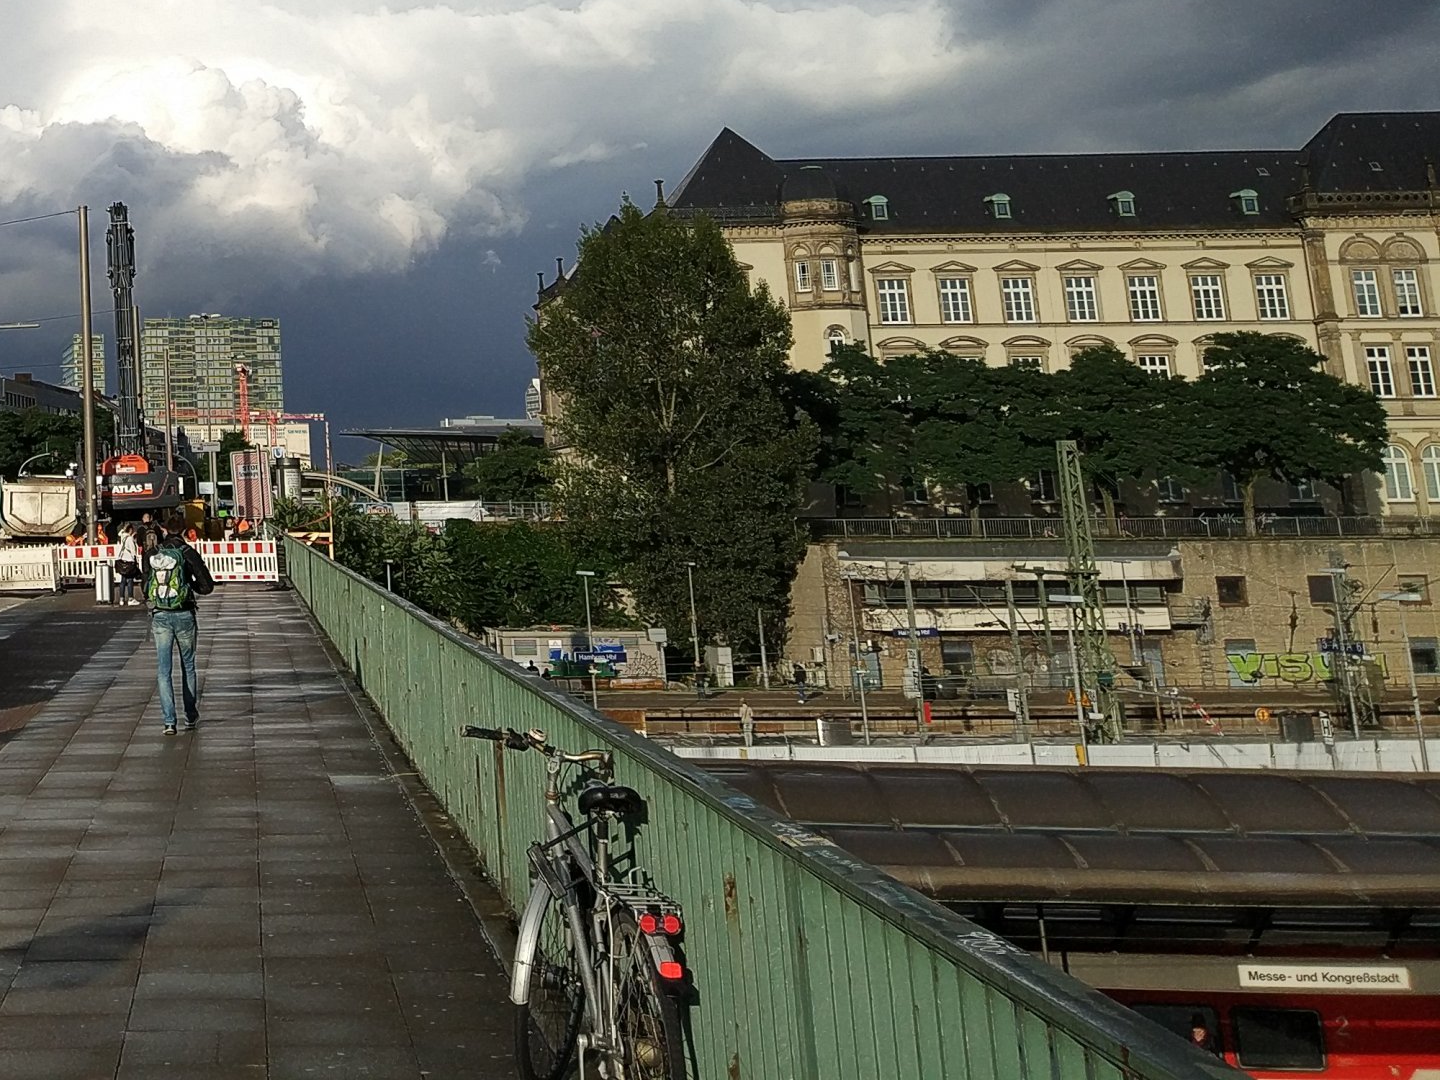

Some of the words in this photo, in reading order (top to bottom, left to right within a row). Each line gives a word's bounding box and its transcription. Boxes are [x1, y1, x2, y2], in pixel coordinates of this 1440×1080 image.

[112, 484, 143, 494] ATLAS
[1247, 971, 1293, 982] Messe-
[1295, 972, 1318, 982] und
[1321, 971, 1401, 985] Kongreßstadt
[1335, 1016, 1350, 1036] 2
